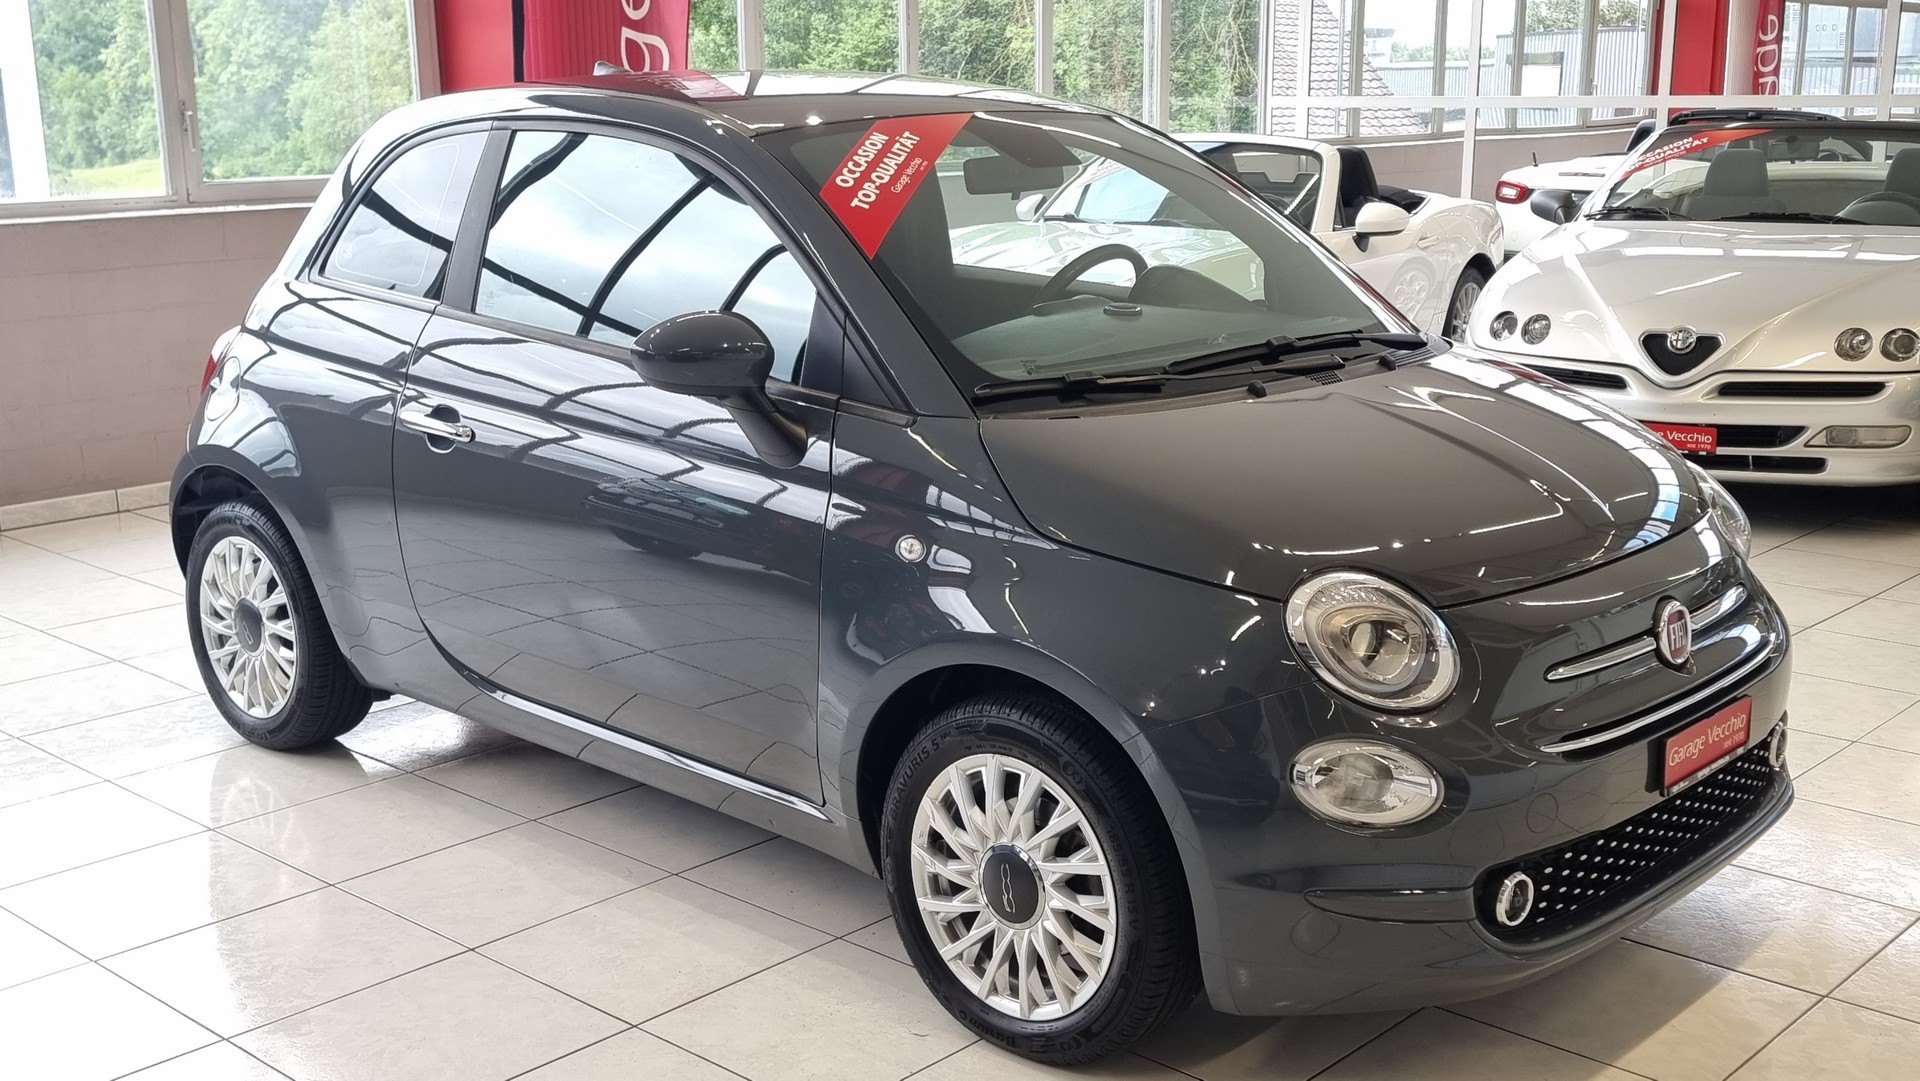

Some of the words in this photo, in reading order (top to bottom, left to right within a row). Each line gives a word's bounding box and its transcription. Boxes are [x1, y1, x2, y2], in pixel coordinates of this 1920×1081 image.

[835, 131, 889, 188] OCCASION
[850, 130, 920, 209] TOP-QUALITÄT
[1636, 137, 1694, 161] CCASION
[1666, 430, 1712, 443] Vecchio
[1669, 619, 1687, 651] FIAT
[1669, 735, 1706, 766] Garage
[1707, 712, 1747, 744] Vecchio
[889, 745, 930, 820] BRAVURIS
